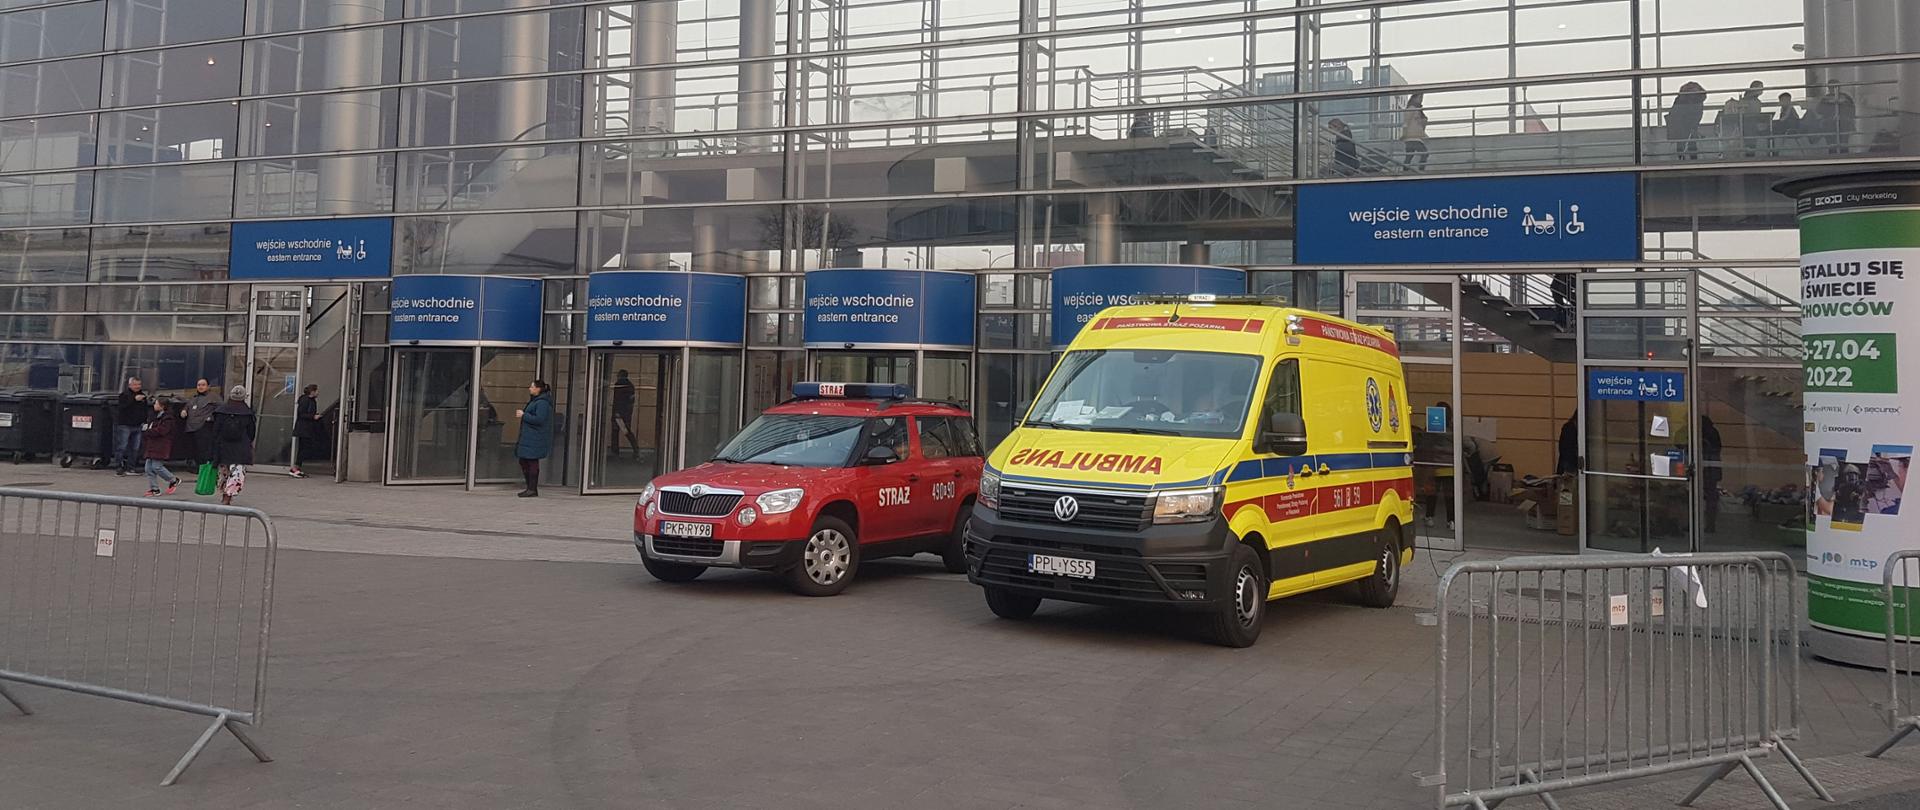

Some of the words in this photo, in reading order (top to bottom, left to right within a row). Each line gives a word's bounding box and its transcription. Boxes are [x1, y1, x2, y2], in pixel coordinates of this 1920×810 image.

[1846, 194, 1860, 202] City
[1861, 192, 1898, 200] Marketing
[1349, 207, 1410, 226] wejście
[1415, 204, 1509, 221] wschodnie
[1374, 228, 1424, 240] eastern
[1428, 226, 1489, 239] entrance
[256, 239, 286, 252] wejście
[287, 238, 332, 249] wschodnie
[267, 254, 292, 262] eastern
[292, 253, 322, 262] entrance
[1867, 260, 1904, 279] SIĘ
[1806, 281, 1877, 299] ŚWIECIE
[411, 297, 475, 309] wschodnie
[615, 294, 682, 307] wschodnie
[842, 293, 914, 308] wschodnie
[1063, 292, 1103, 309] wejście
[417, 313, 459, 323] entrance
[594, 313, 620, 321] eastern
[622, 312, 667, 322] entrance
[817, 313, 848, 322] eastern
[850, 312, 899, 323] entrance
[1597, 376, 1633, 387] wejście
[1806, 366, 1853, 387] 2022
[1597, 387, 1633, 396] entrance
[878, 486, 911, 507] STRAŻ
[665, 522, 685, 534] PKR
[687, 523, 711, 536] RY98
[1035, 556, 1057, 571] PPL
[1062, 558, 1092, 575] YS55
[1849, 558, 1878, 570] mtp
[1611, 605, 1626, 613] mtp
